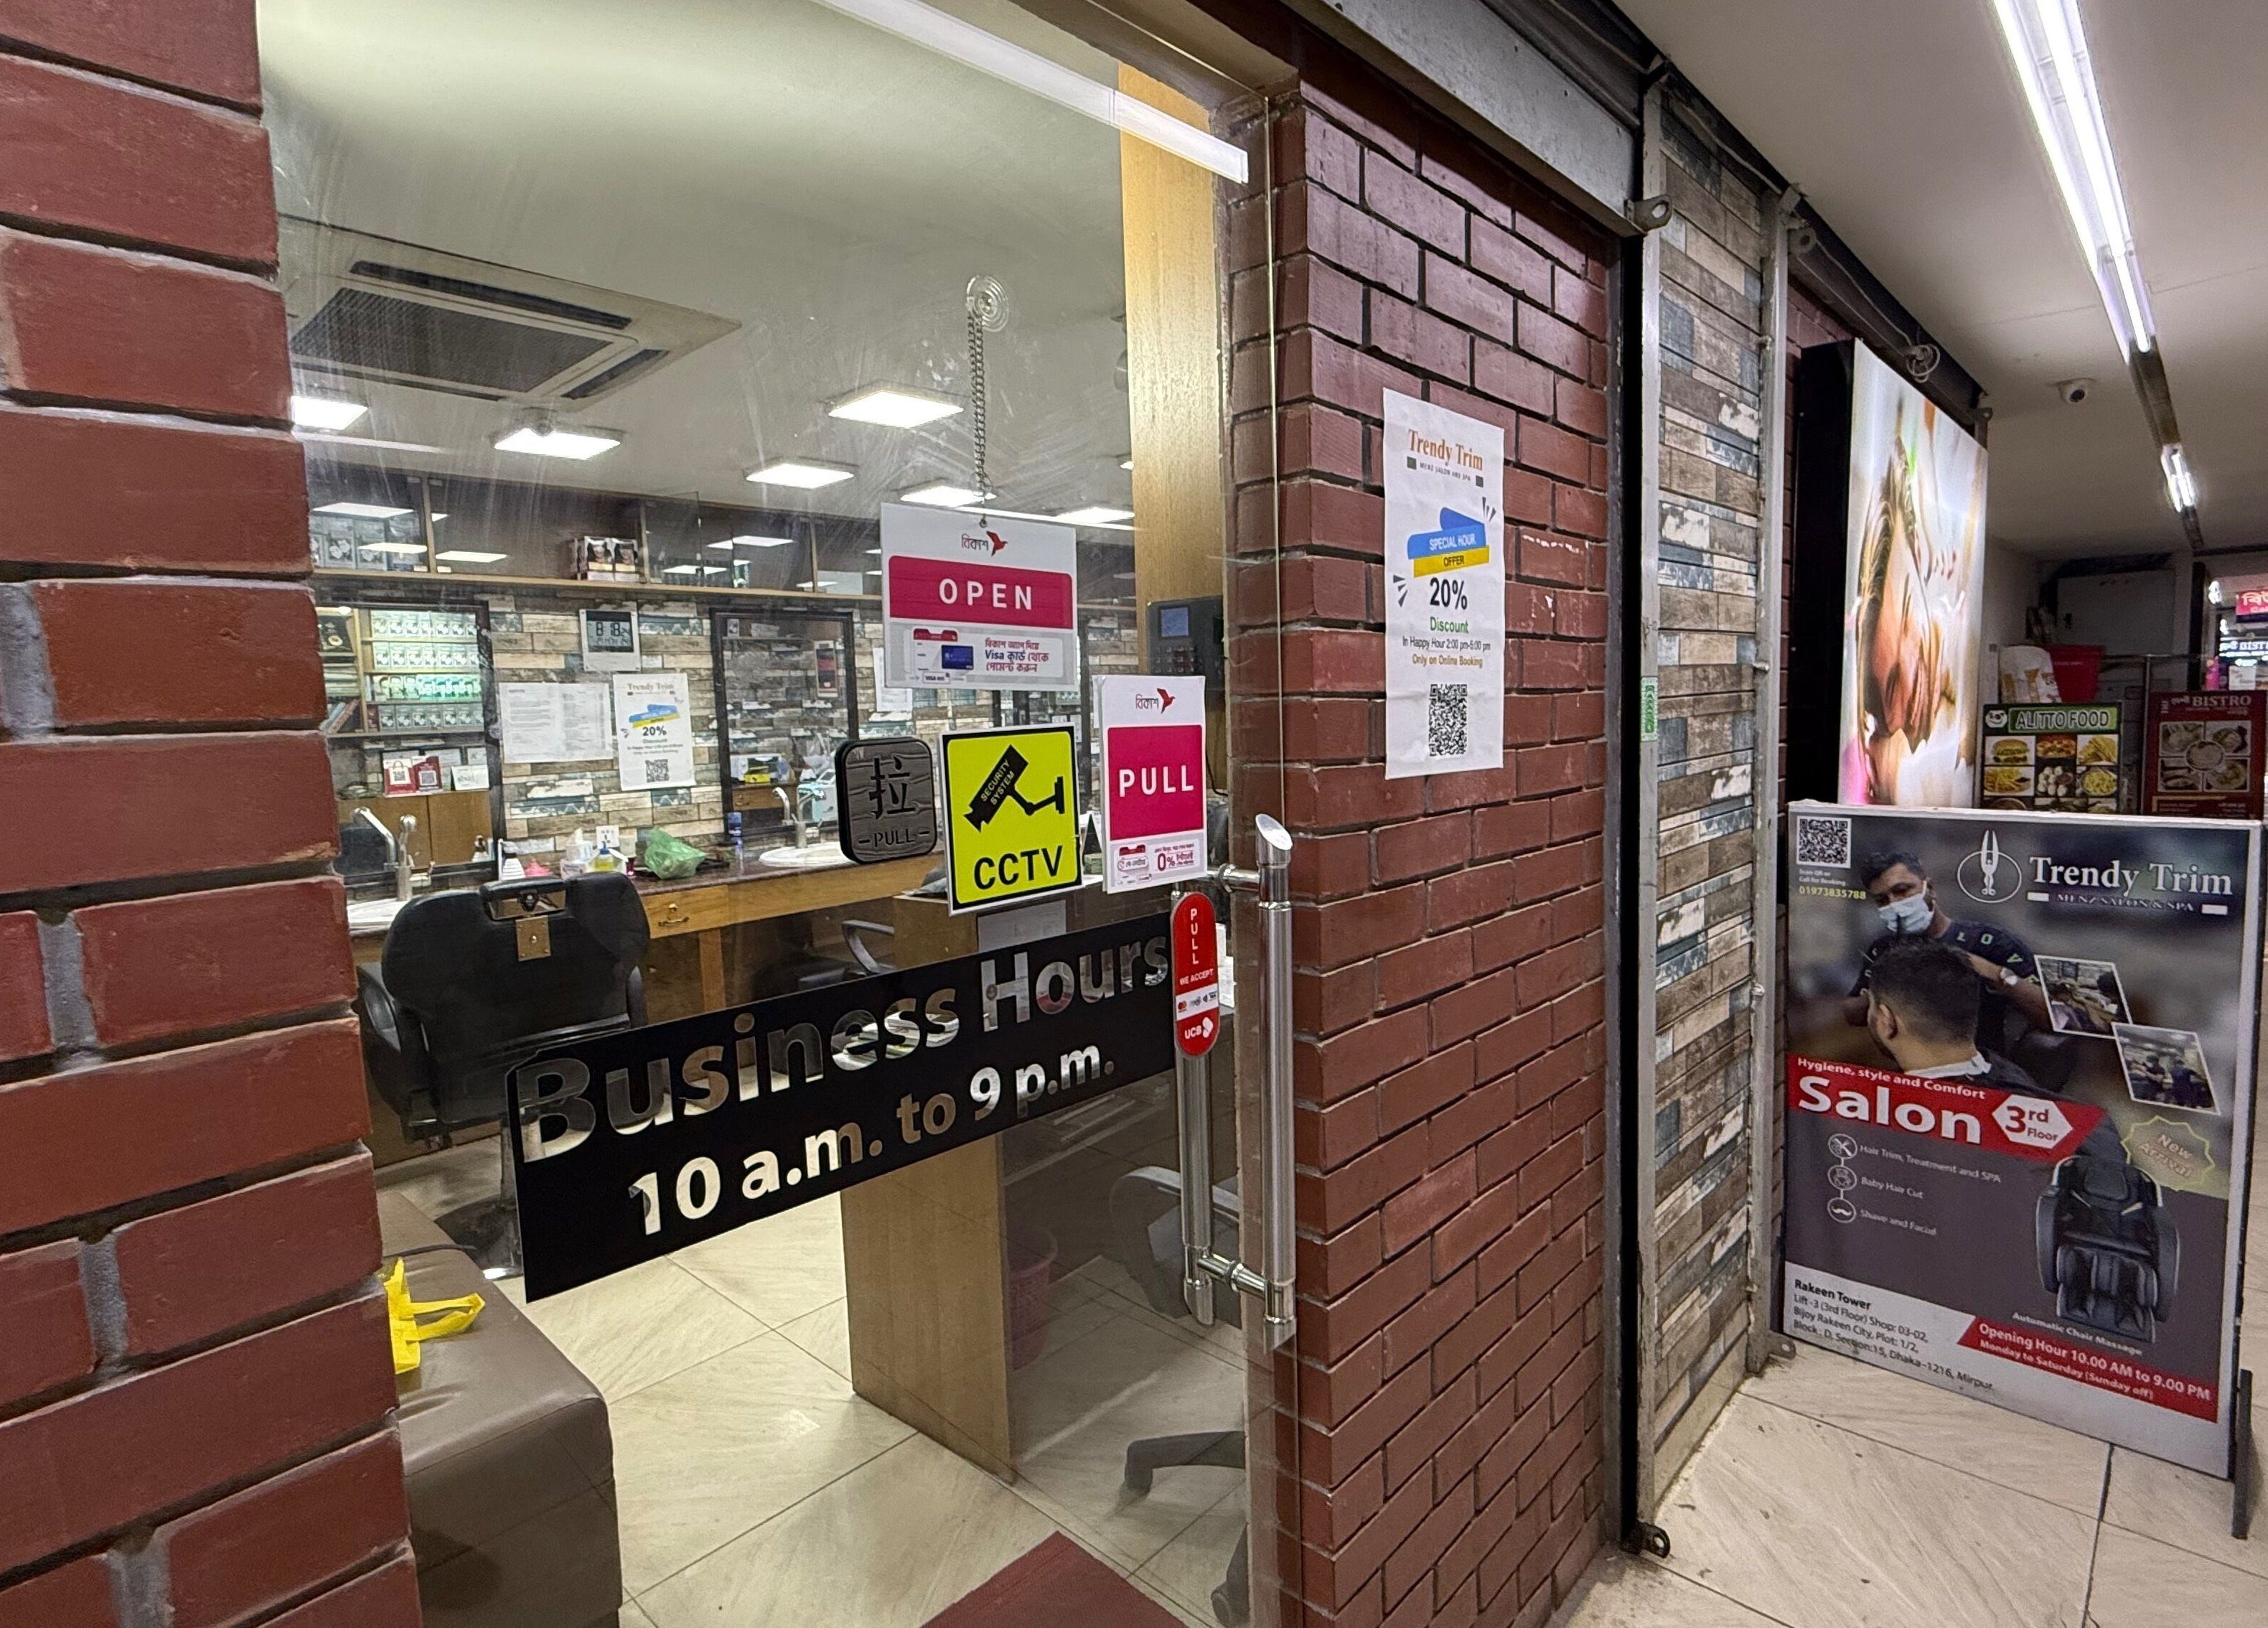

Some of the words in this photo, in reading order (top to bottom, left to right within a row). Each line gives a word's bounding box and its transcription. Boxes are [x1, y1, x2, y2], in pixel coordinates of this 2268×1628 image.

[1408, 429, 1453, 466] Trendy
[1456, 444, 1483, 471] Trim
[961, 533, 989, 551] বিকাশ
[1429, 536, 1457, 551] SPECIAL
[1458, 533, 1476, 546] HOUR
[1443, 555, 1465, 566] OFFER
[939, 579, 1032, 610] OPEN
[1430, 577, 1468, 610] 20%
[1430, 617, 1469, 633] Discount
[985, 650, 1005, 660] Visa
[1402, 636, 1408, 646] In
[1410, 636, 1430, 650] Happy
[1432, 637, 1445, 648] Hour
[1446, 639, 1458, 649] 2:00
[1412, 654, 1427, 667] Only
[1439, 655, 1457, 665] Online
[1459, 655, 1483, 668] Booking
[1135, 693, 1159, 709] বিকাশ
[2192, 695, 2252, 707] BISTRO
[642, 726, 667, 736] 20%
[2015, 710, 2066, 729] ALITTO
[2068, 708, 2110, 728] FOOD
[868, 756, 916, 820] 拉
[980, 759, 1011, 802] SECURITY
[990, 770, 1015, 805] SYSTEM
[1119, 764, 1194, 797] PULL
[974, 845, 1063, 890] CCTV
[1158, 853, 1176, 871] 0%
[2030, 856, 2140, 897] Trendy
[2150, 862, 2233, 895] Trim
[1190, 908, 1199, 965] PULL
[1179, 976, 1189, 986] WE
[1190, 968, 1214, 982] ACCEPT
[1185, 1025, 1201, 1039] UCB
[516, 988, 961, 1164] Business
[981, 935, 1169, 1032] Hours
[1797, 1057, 1856, 1076] Hygiene,
[1858, 1068, 1890, 1082] style
[1893, 1075, 1921, 1087] and
[1924, 1080, 1987, 1100] Comfort
[1798, 1076, 1982, 1144] Salon
[2005, 1106, 2049, 1133] 3rd
[628, 1156, 721, 1236] 10
[741, 1122, 884, 1199] a.m.
[896, 1093, 956, 1144] to
[970, 1066, 1001, 1121] 9
[1015, 1042, 1115, 1119] p.m.
[2027, 1127, 2058, 1142] Floor
[2157, 1134, 2193, 1159] New
[1860, 1144, 1878, 1156] Hair
[1906, 1154, 1957, 1173] Treatment
[1959, 1167, 1979, 1179] and
[1982, 1171, 2001, 1183] SPA
[1861, 1176, 1884, 1190] Baby
[1885, 1183, 1904, 1194] Hair
[1907, 1188, 1923, 1199] Cut
[1860, 1210, 1888, 1223] Shave
[1890, 1217, 1908, 1228] and
[1910, 1221, 1937, 1235] Facial
[1794, 1278, 1835, 1299] Rakeen
[1837, 1291, 1872, 1310] Tower
[1794, 1293, 1808, 1306] Lift
[1821, 1302, 1839, 1315] (3rd
[1841, 1308, 1868, 1324] Floor)
[1870, 1316, 1896, 1332] Shop:
[1898, 1325, 1929, 1343] 03-02,
[1794, 1306, 1815, 1321] Bijoy
[1817, 1313, 1852, 1331] Rakeen
[2012, 1312, 2065, 1333] Automatic
[2066, 1327, 2093, 1341] Chair
[2095, 1336, 2142, 1357] Massage
[1979, 1323, 2033, 1349] Opening
[2035, 1339, 2067, 1357] Hour
[2071, 1349, 2108, 1370] 10.00
[2109, 1362, 2133, 1377] AM
[2135, 1370, 2151, 1383] to
[2153, 1375, 2185, 1393] 9.00
[2187, 1384, 2211, 1400] PM
[1980, 1339, 2021, 1360] Monday
[2023, 1352, 2034, 1362] to
[2035, 1356, 2084, 1378] Saturday
[2085, 1371, 2130, 1393] (Sunday
[2132, 1386, 2154, 1400] off)
